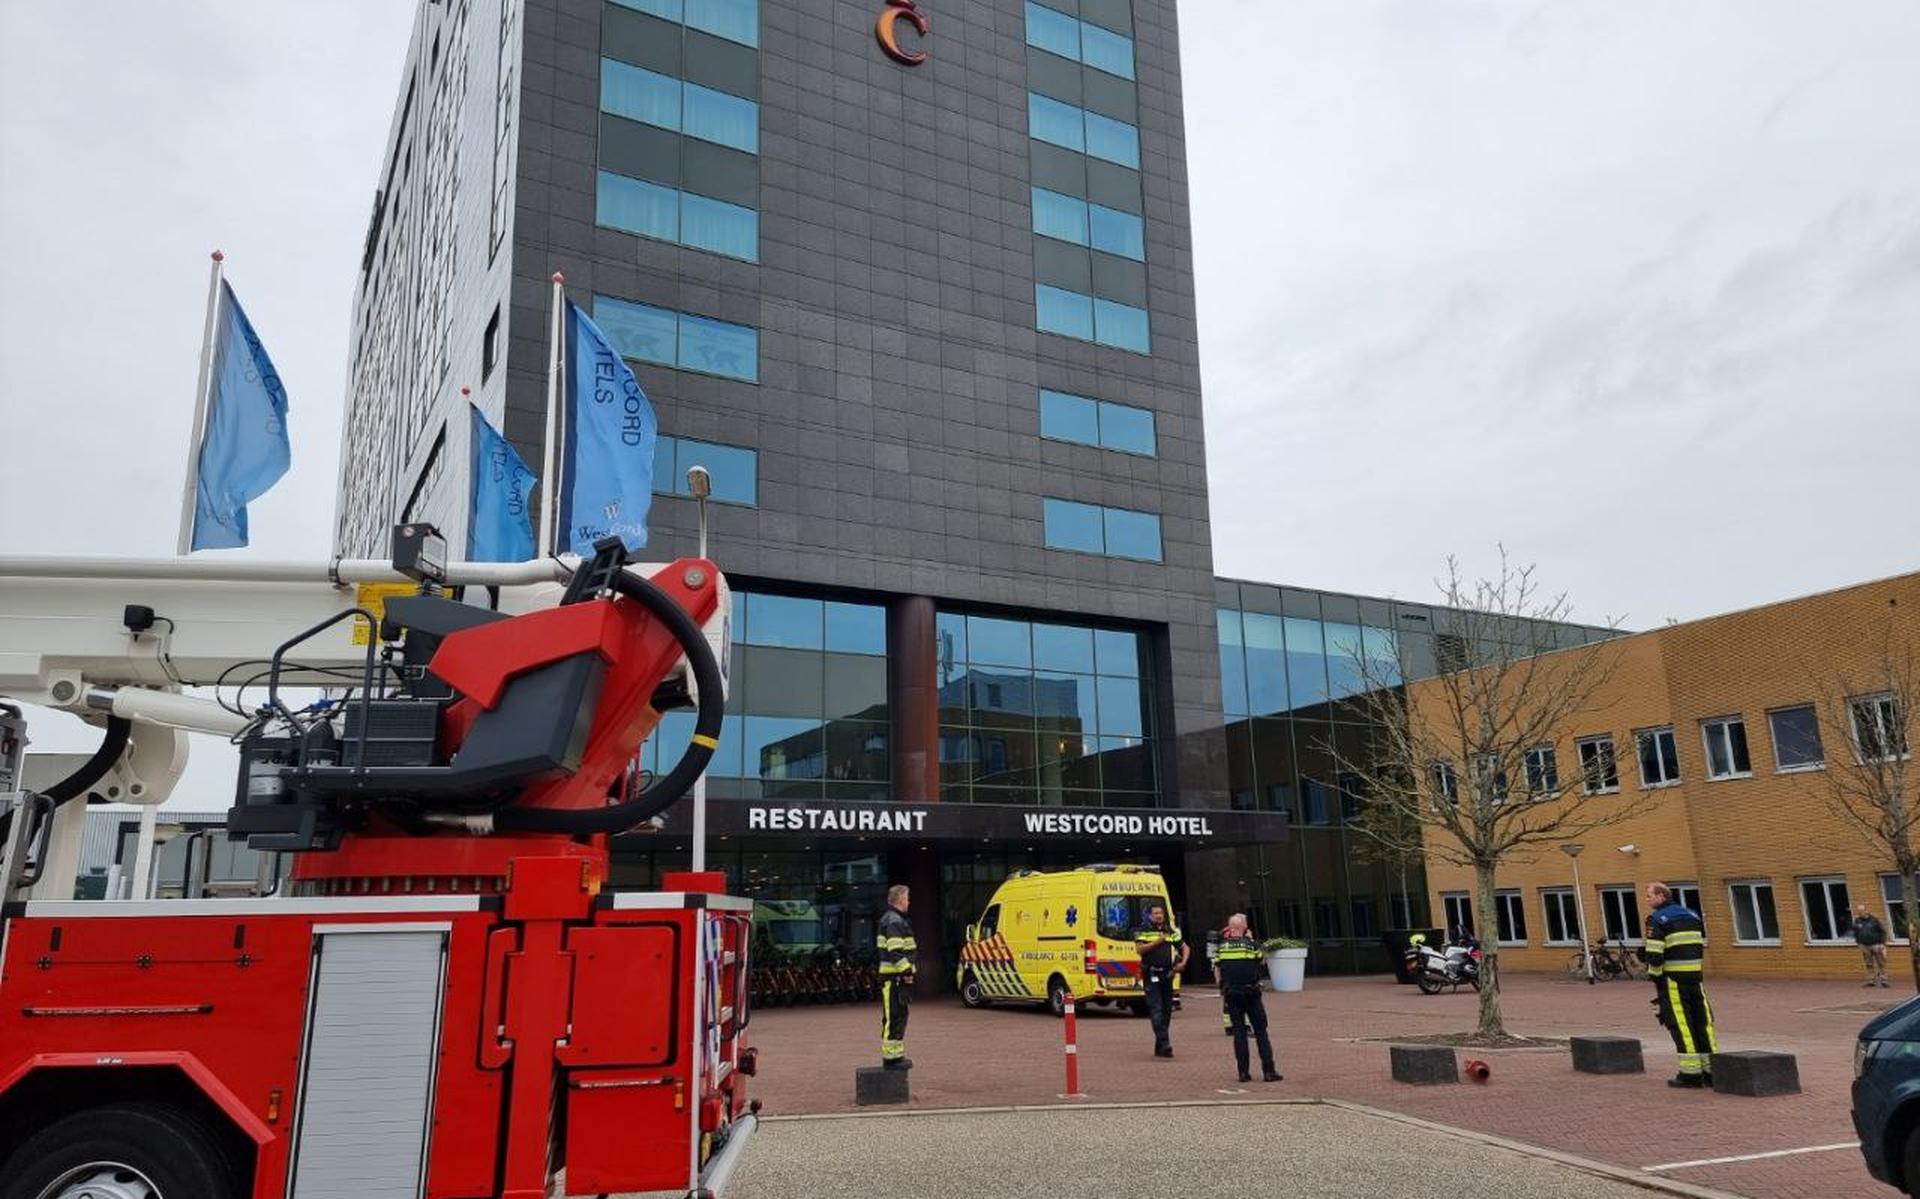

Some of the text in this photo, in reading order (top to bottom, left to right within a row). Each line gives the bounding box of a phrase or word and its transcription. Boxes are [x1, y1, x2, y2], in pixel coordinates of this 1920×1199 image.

[594, 337, 615, 405] TELS
[621, 366, 642, 447] CORD
[749, 808, 928, 832] RESTAURANT
[1024, 812, 1213, 837] WESTCORD HOTEL
